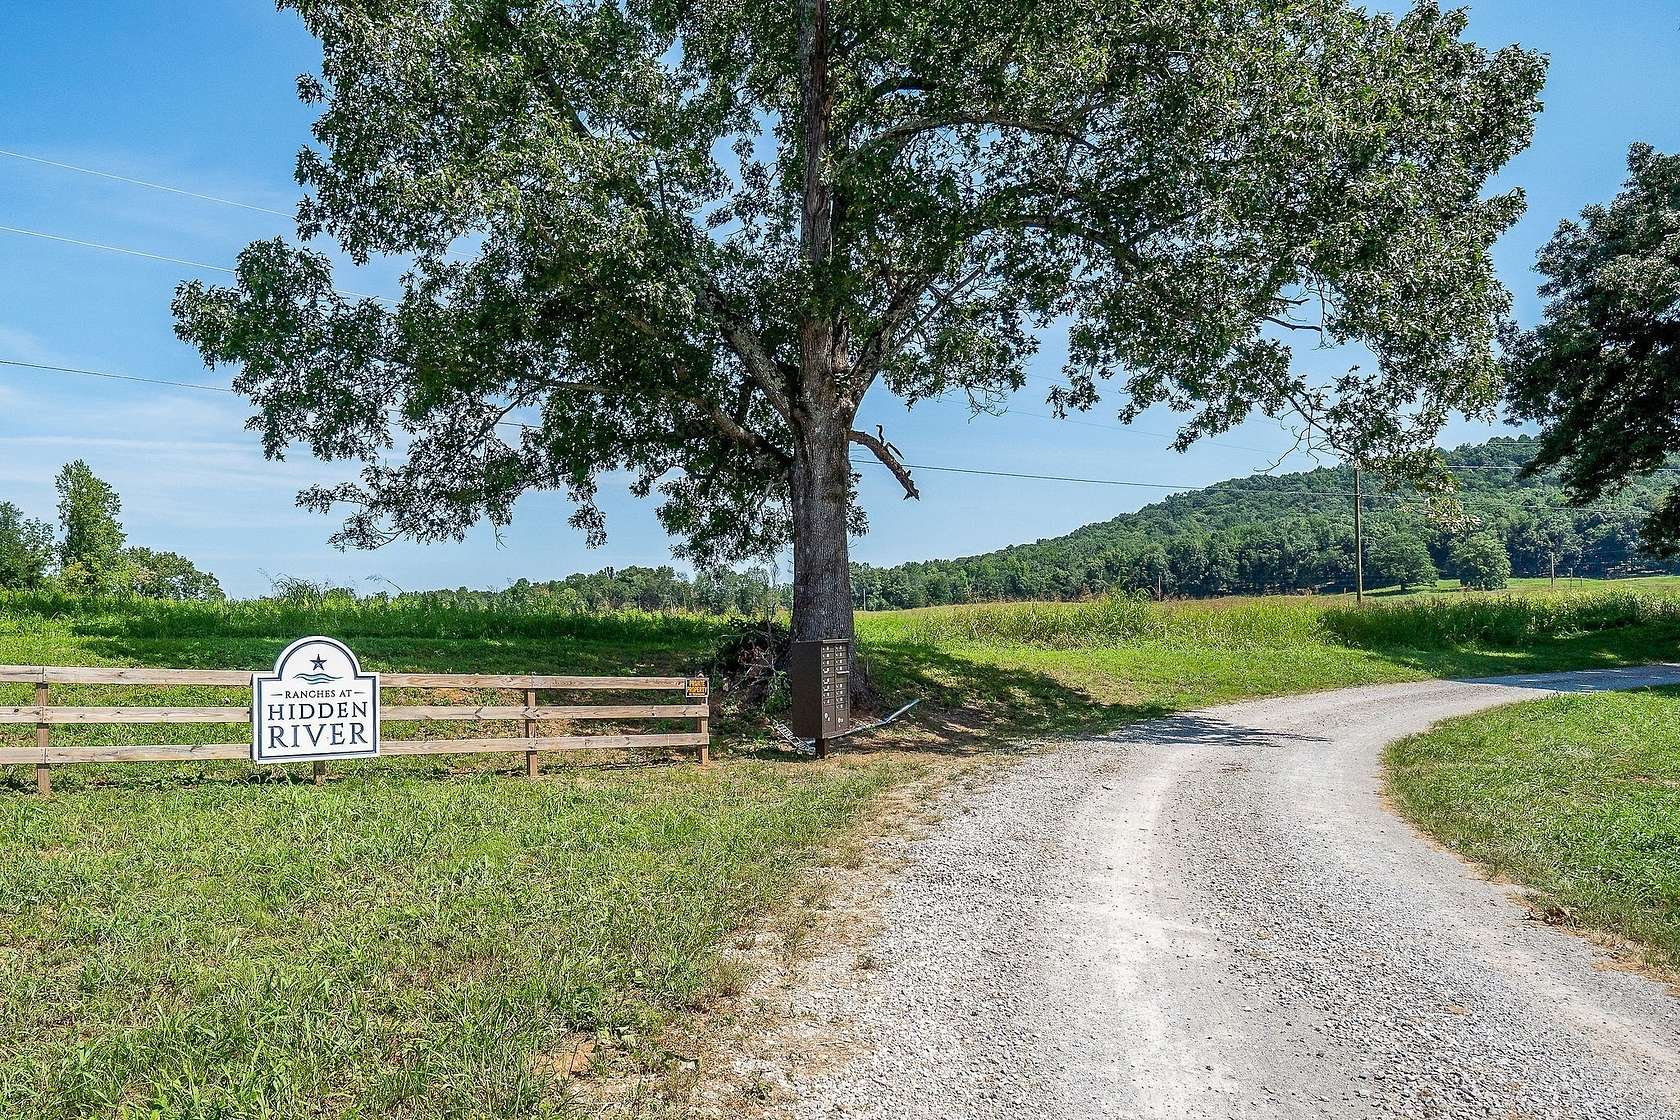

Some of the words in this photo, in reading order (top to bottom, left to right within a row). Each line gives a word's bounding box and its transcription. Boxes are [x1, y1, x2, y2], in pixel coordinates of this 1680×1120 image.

[285, 690, 336, 699] RANCHES
[339, 690, 353, 698] AT
[268, 702, 367, 720] HIDDEN
[268, 723, 368, 749] RIVER
